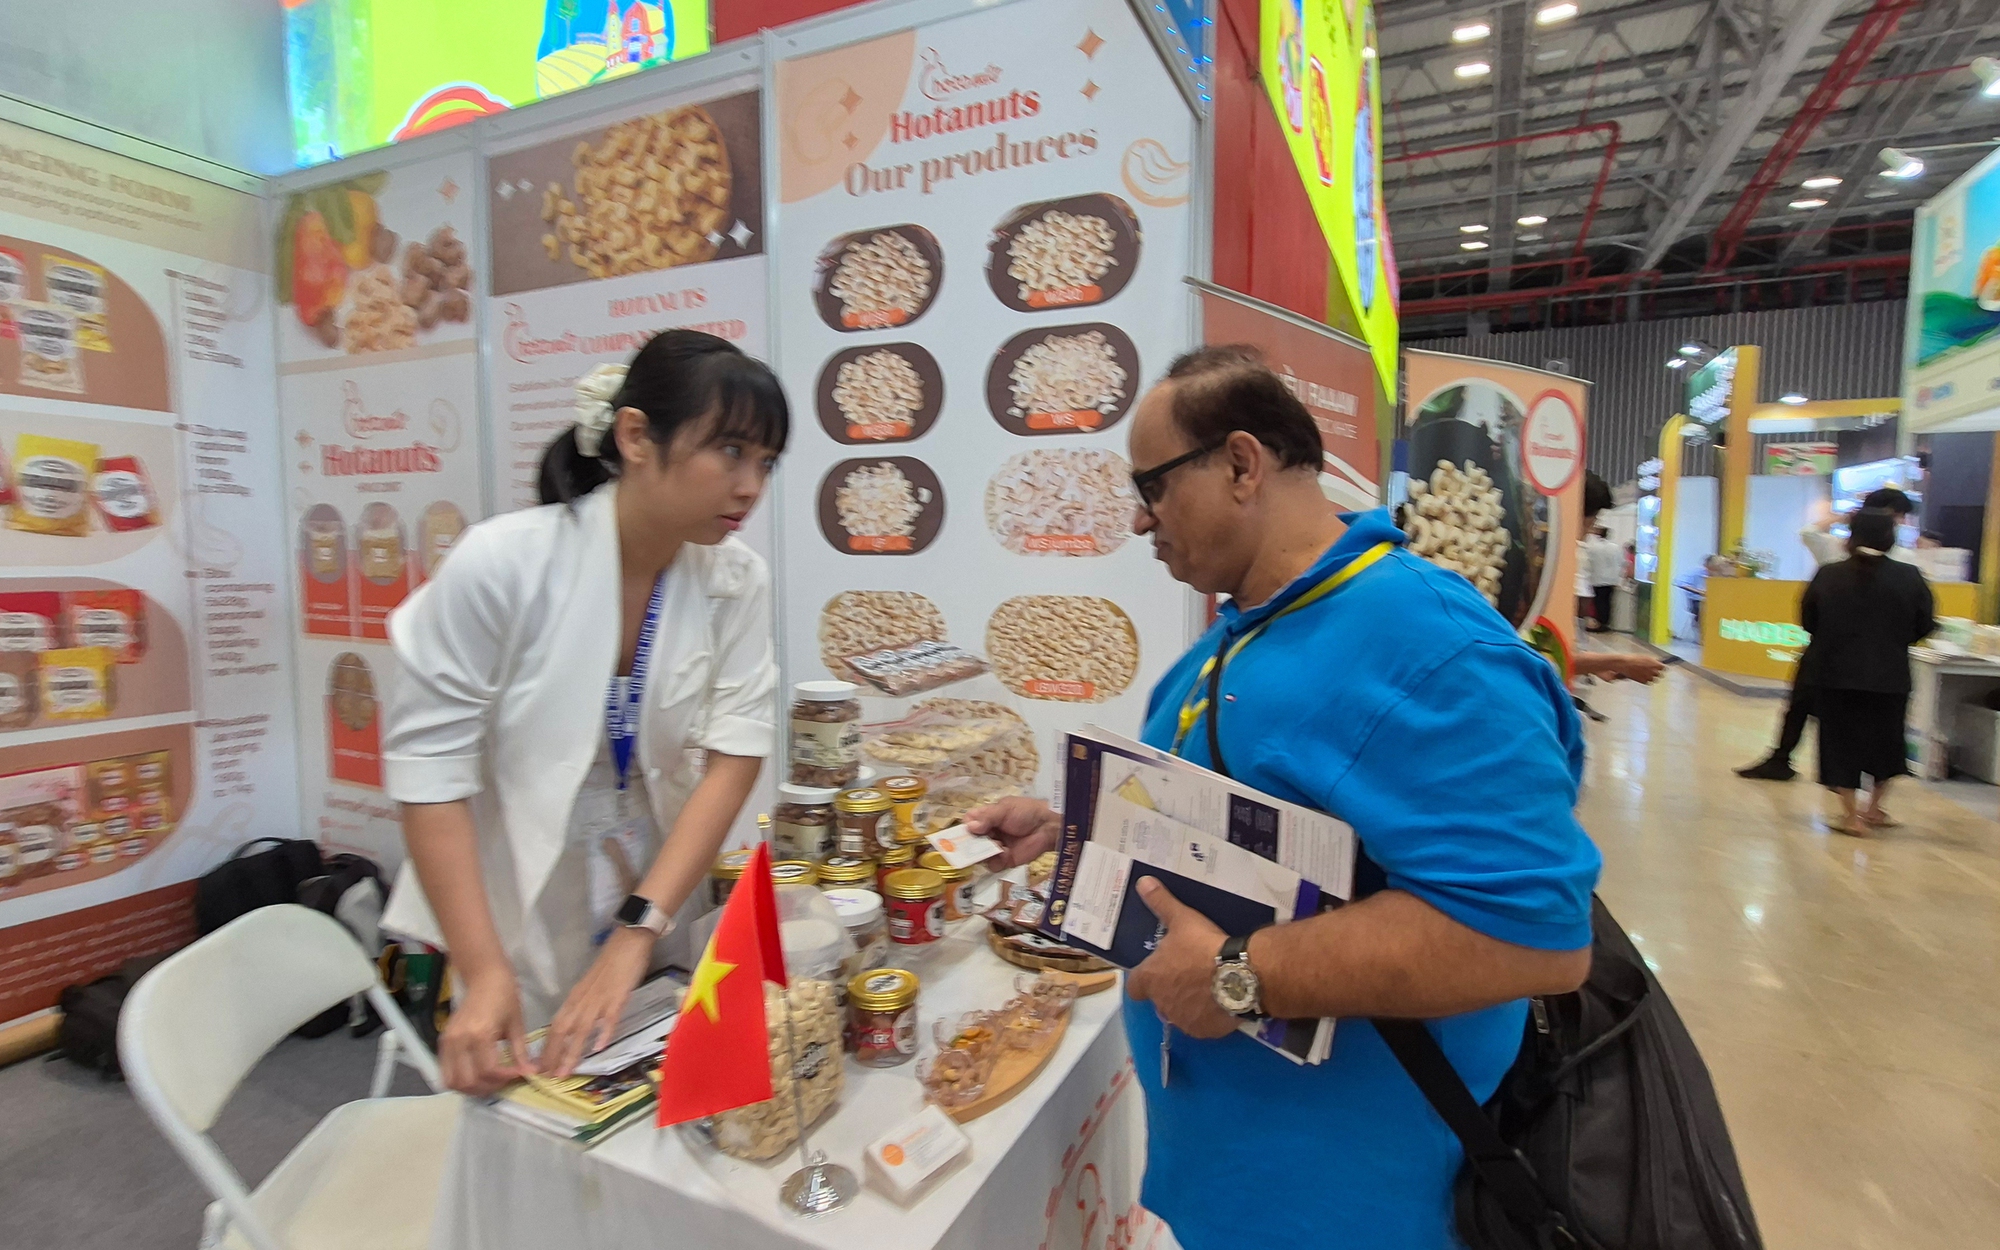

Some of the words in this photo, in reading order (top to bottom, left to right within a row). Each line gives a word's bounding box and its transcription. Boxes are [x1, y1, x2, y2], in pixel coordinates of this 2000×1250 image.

[889, 88, 1042, 144] Hotanuts
[843, 161, 914, 198] Our
[920, 128, 1099, 195] produces
[320, 439, 443, 476] Hotanuts
